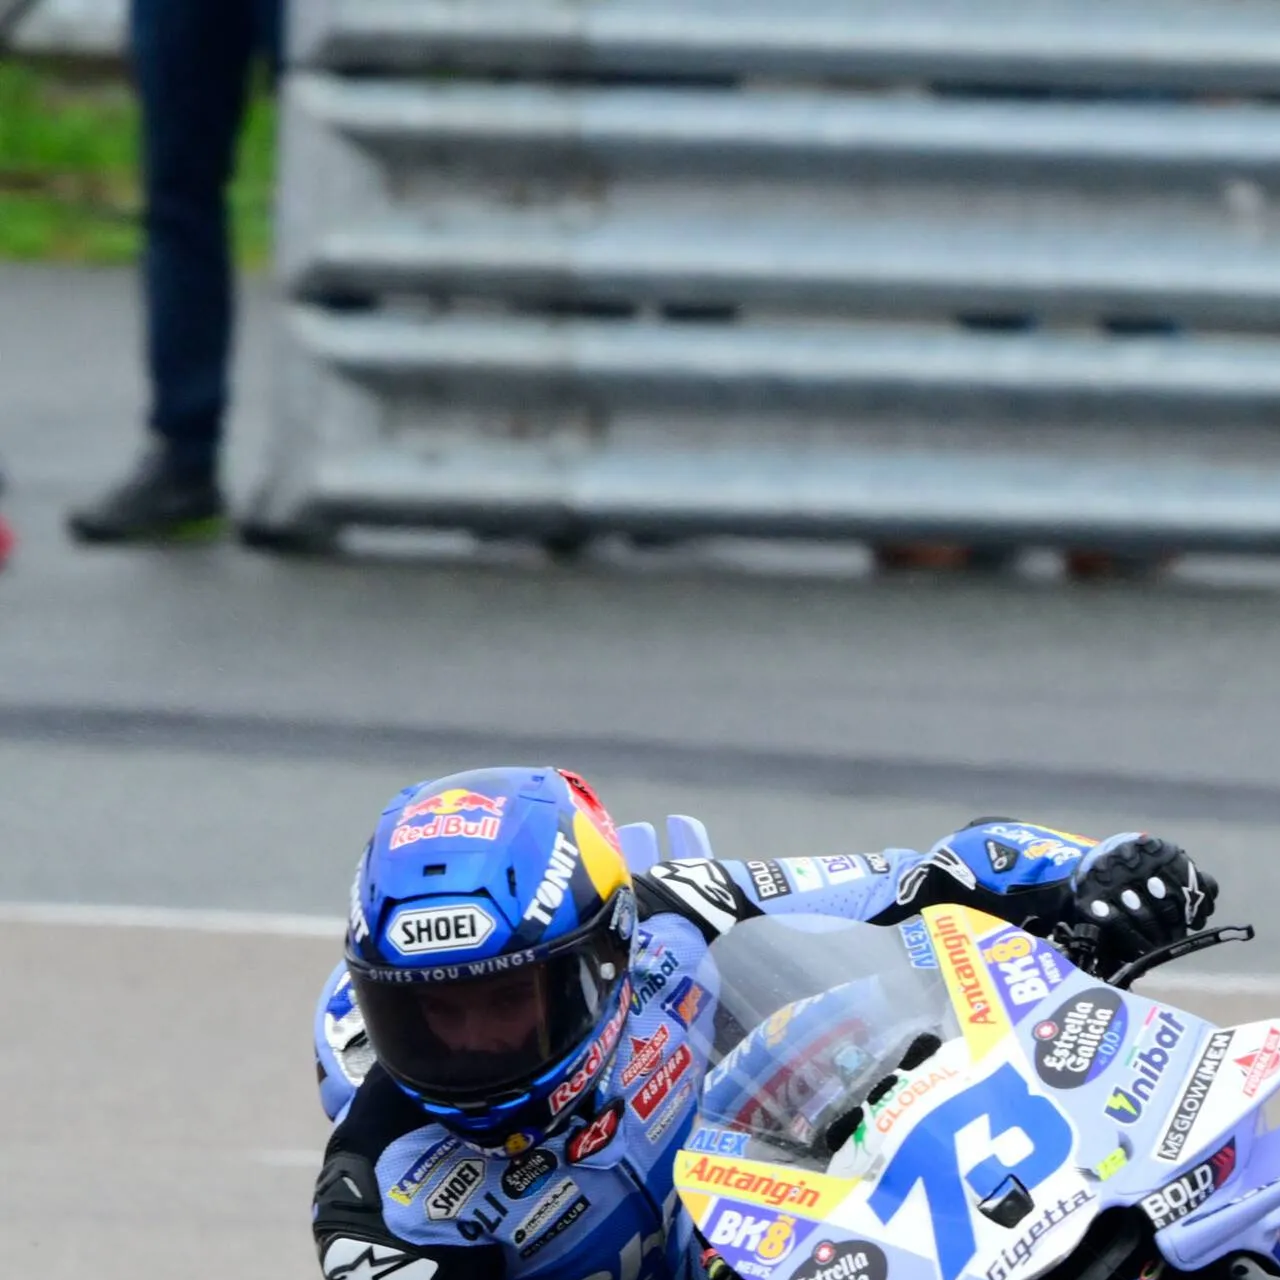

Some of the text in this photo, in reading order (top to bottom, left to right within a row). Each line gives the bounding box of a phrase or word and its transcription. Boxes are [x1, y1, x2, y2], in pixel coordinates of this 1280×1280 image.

[390, 815, 500, 849] Red Bull
[524, 831, 578, 925] TONIT
[401, 914, 477, 945] SHOEI
[901, 920, 939, 970] ALEX
[369, 950, 536, 983] GIVES YOU WINGS
[934, 915, 997, 1025] Antangin
[990, 935, 1050, 1007] BK8
[1043, 1001, 1095, 1073] Estrella
[1064, 1007, 1115, 1073] Galicia
[1104, 1010, 1186, 1125] Unibat
[1169, 1078, 1210, 1133] GLOW
[1196, 1029, 1233, 1077] MEN
[876, 1066, 958, 1133] GLOBAL
[689, 1127, 750, 1156] ALEX
[434, 1163, 480, 1217] SHOEI
[686, 1156, 821, 1209] Antangin
[1141, 1163, 1214, 1220] BOLD
[710, 1209, 793, 1259] BK8
